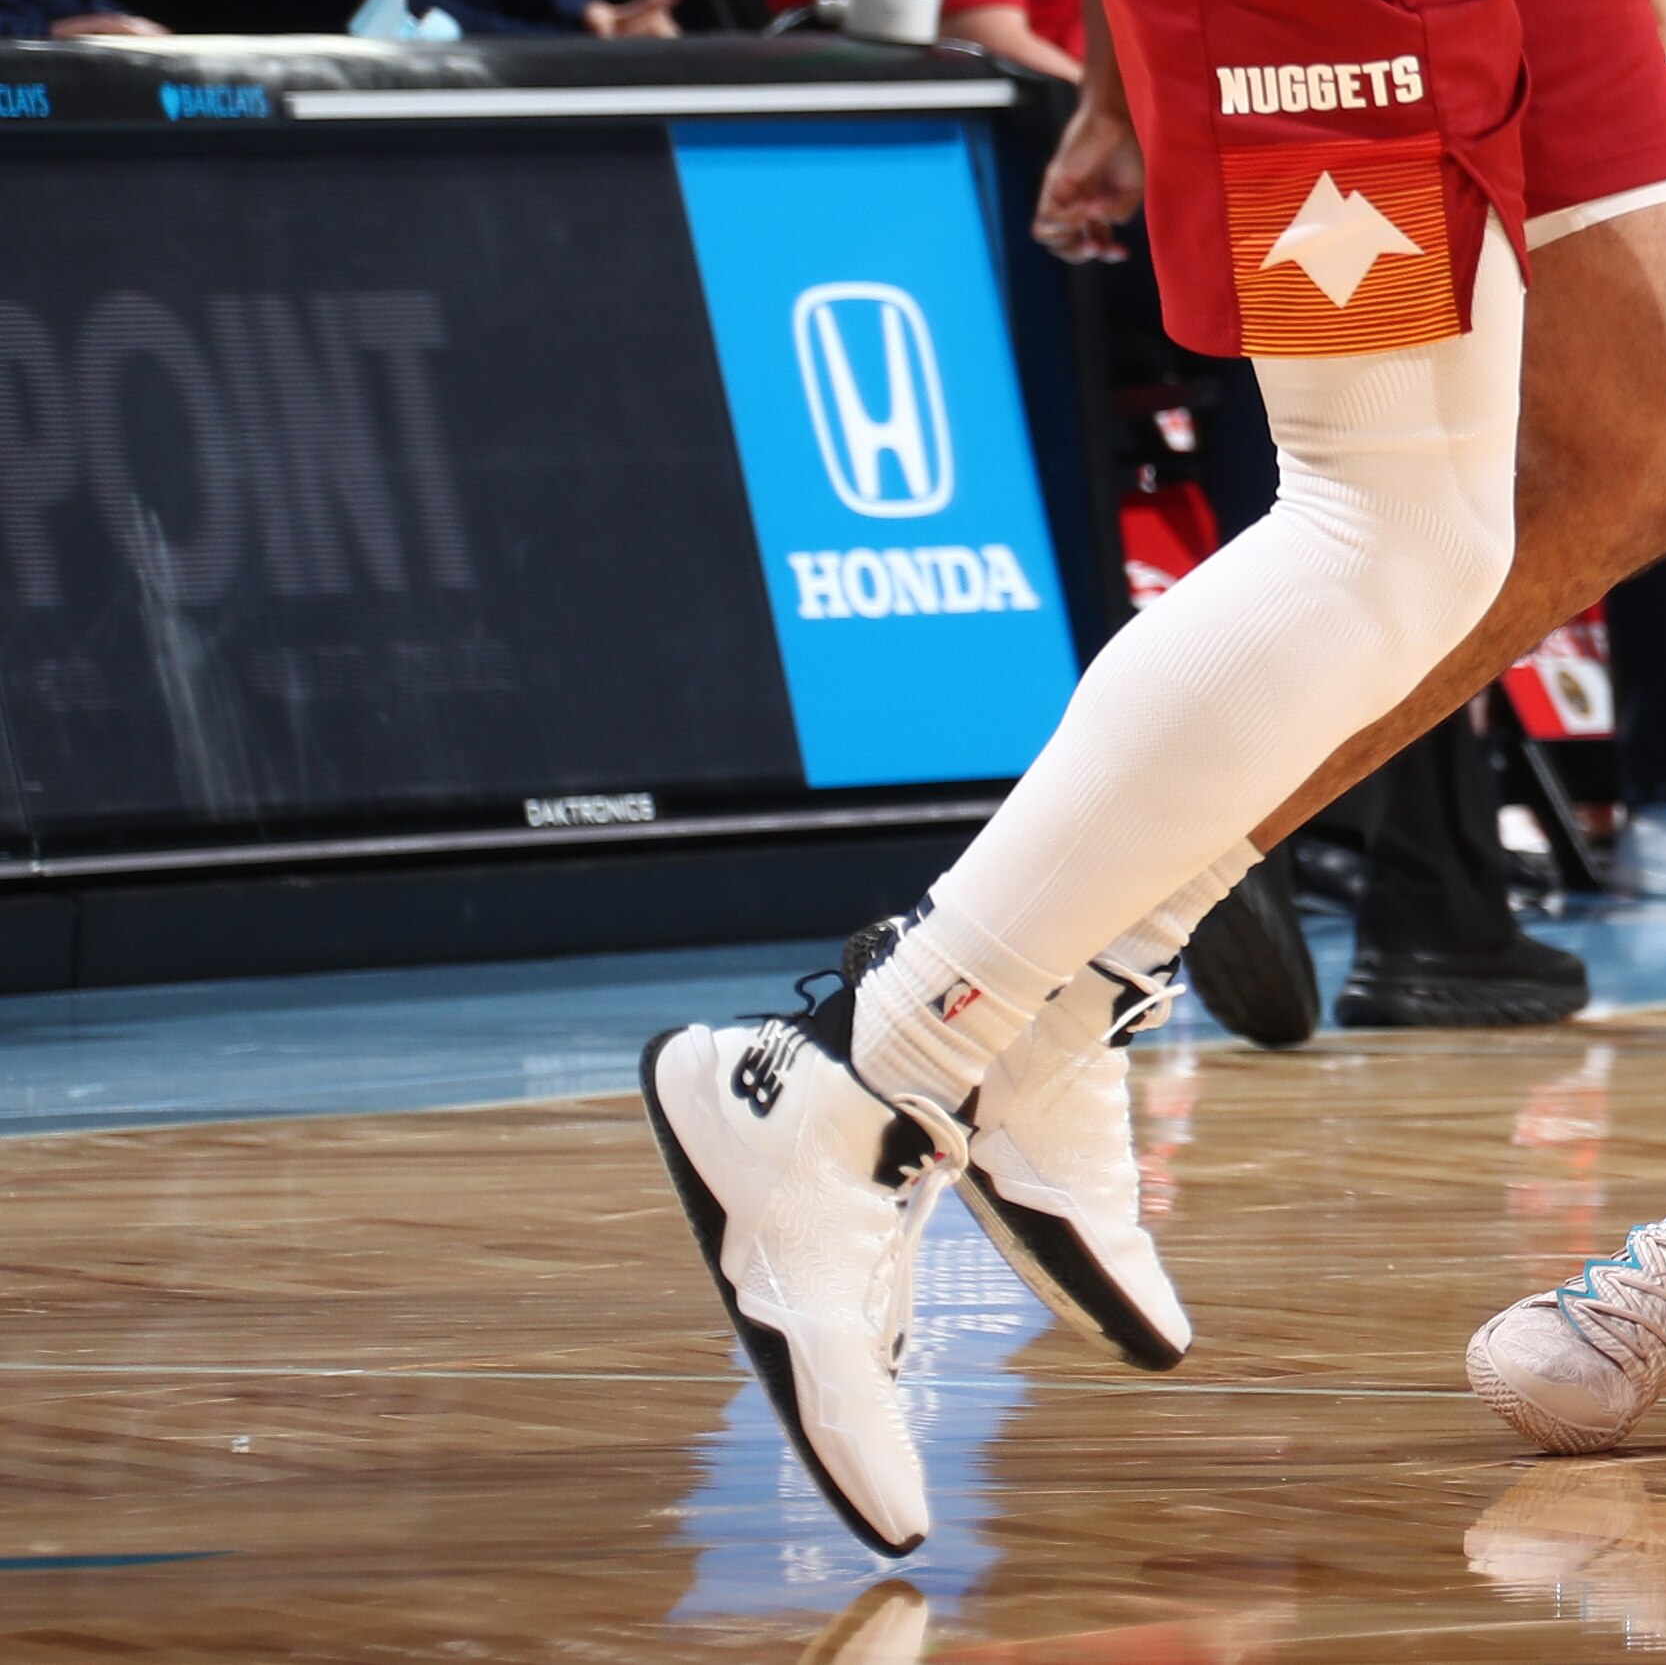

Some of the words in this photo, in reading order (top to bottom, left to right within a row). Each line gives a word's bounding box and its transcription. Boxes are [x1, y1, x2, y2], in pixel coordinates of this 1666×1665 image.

[180, 85, 268, 118] BARCLAYS
[1217, 55, 1424, 115] NUGGETS
[0, 291, 479, 606] POINT
[788, 544, 1040, 619] HONDA
